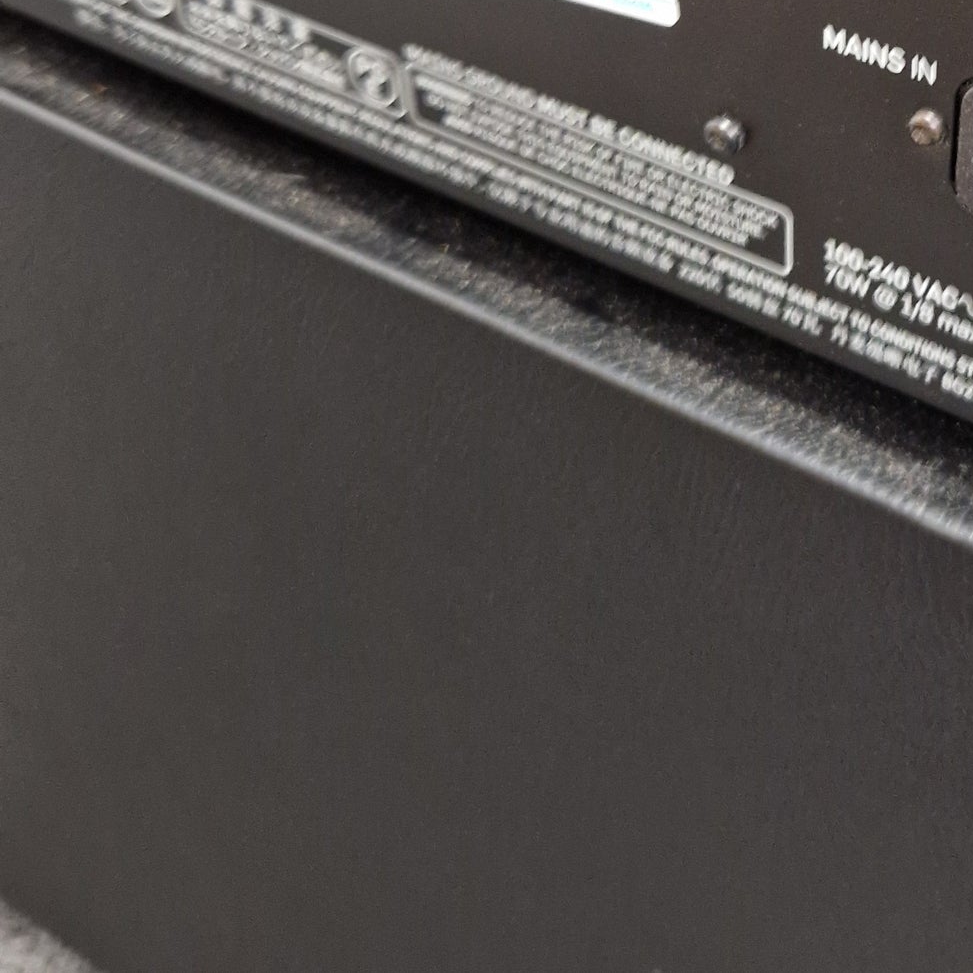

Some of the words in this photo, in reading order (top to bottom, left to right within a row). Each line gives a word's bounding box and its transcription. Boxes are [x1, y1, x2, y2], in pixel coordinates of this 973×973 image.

[822, 24, 906, 74] MAINS
[910, 54, 938, 86] IN
[823, 237, 911, 292] 100-240
